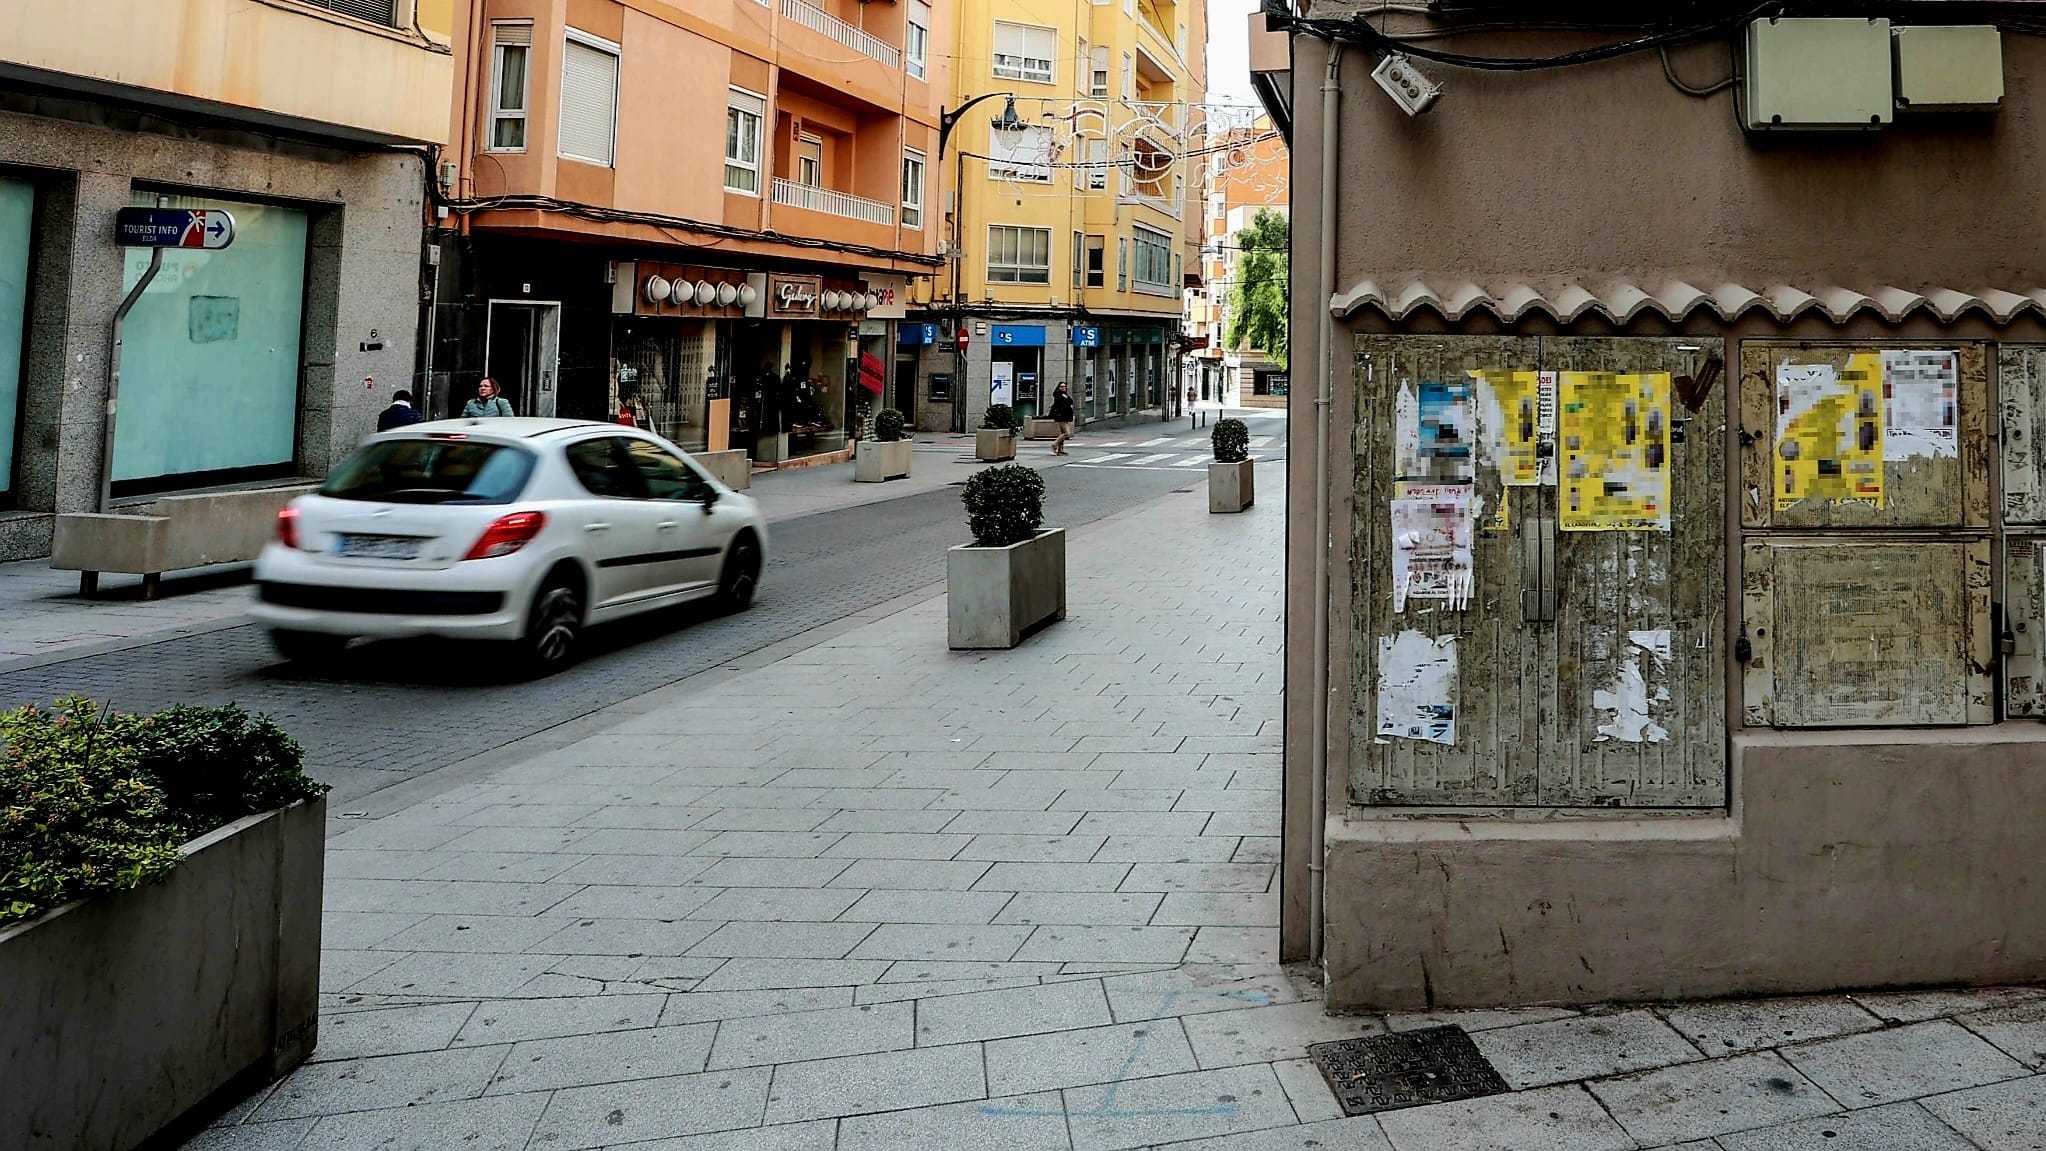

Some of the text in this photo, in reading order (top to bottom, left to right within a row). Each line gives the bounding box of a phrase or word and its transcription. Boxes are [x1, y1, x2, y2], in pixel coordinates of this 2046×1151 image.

[123, 224, 178, 235] TOURIST INFO
[1080, 339, 1095, 347] ATM
